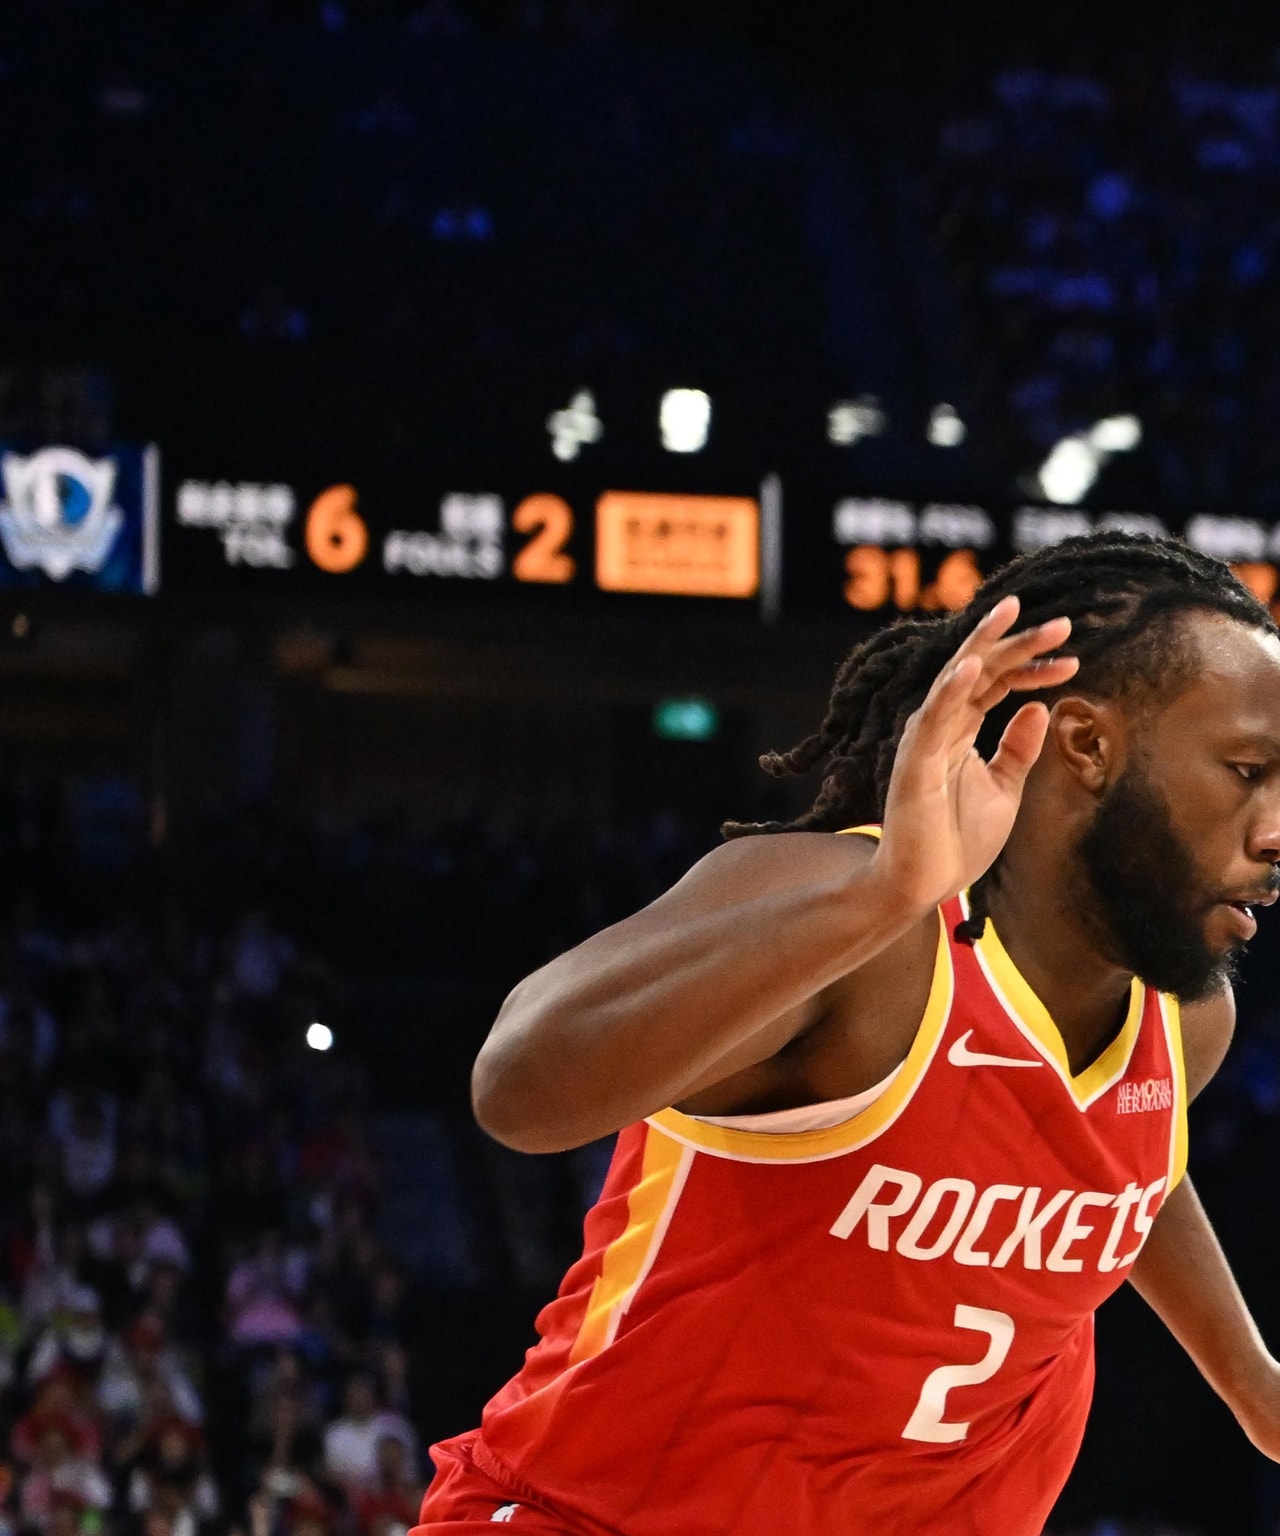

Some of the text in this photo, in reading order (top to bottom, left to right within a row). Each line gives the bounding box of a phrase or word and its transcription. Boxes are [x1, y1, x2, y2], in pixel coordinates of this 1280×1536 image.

[305, 484, 368, 573] 6
[512, 494, 574, 584] 2
[1117, 1091, 1171, 1114] HERMANN
[829, 1164, 1168, 1273] ROCKETS
[901, 1303, 1015, 1444] 2
